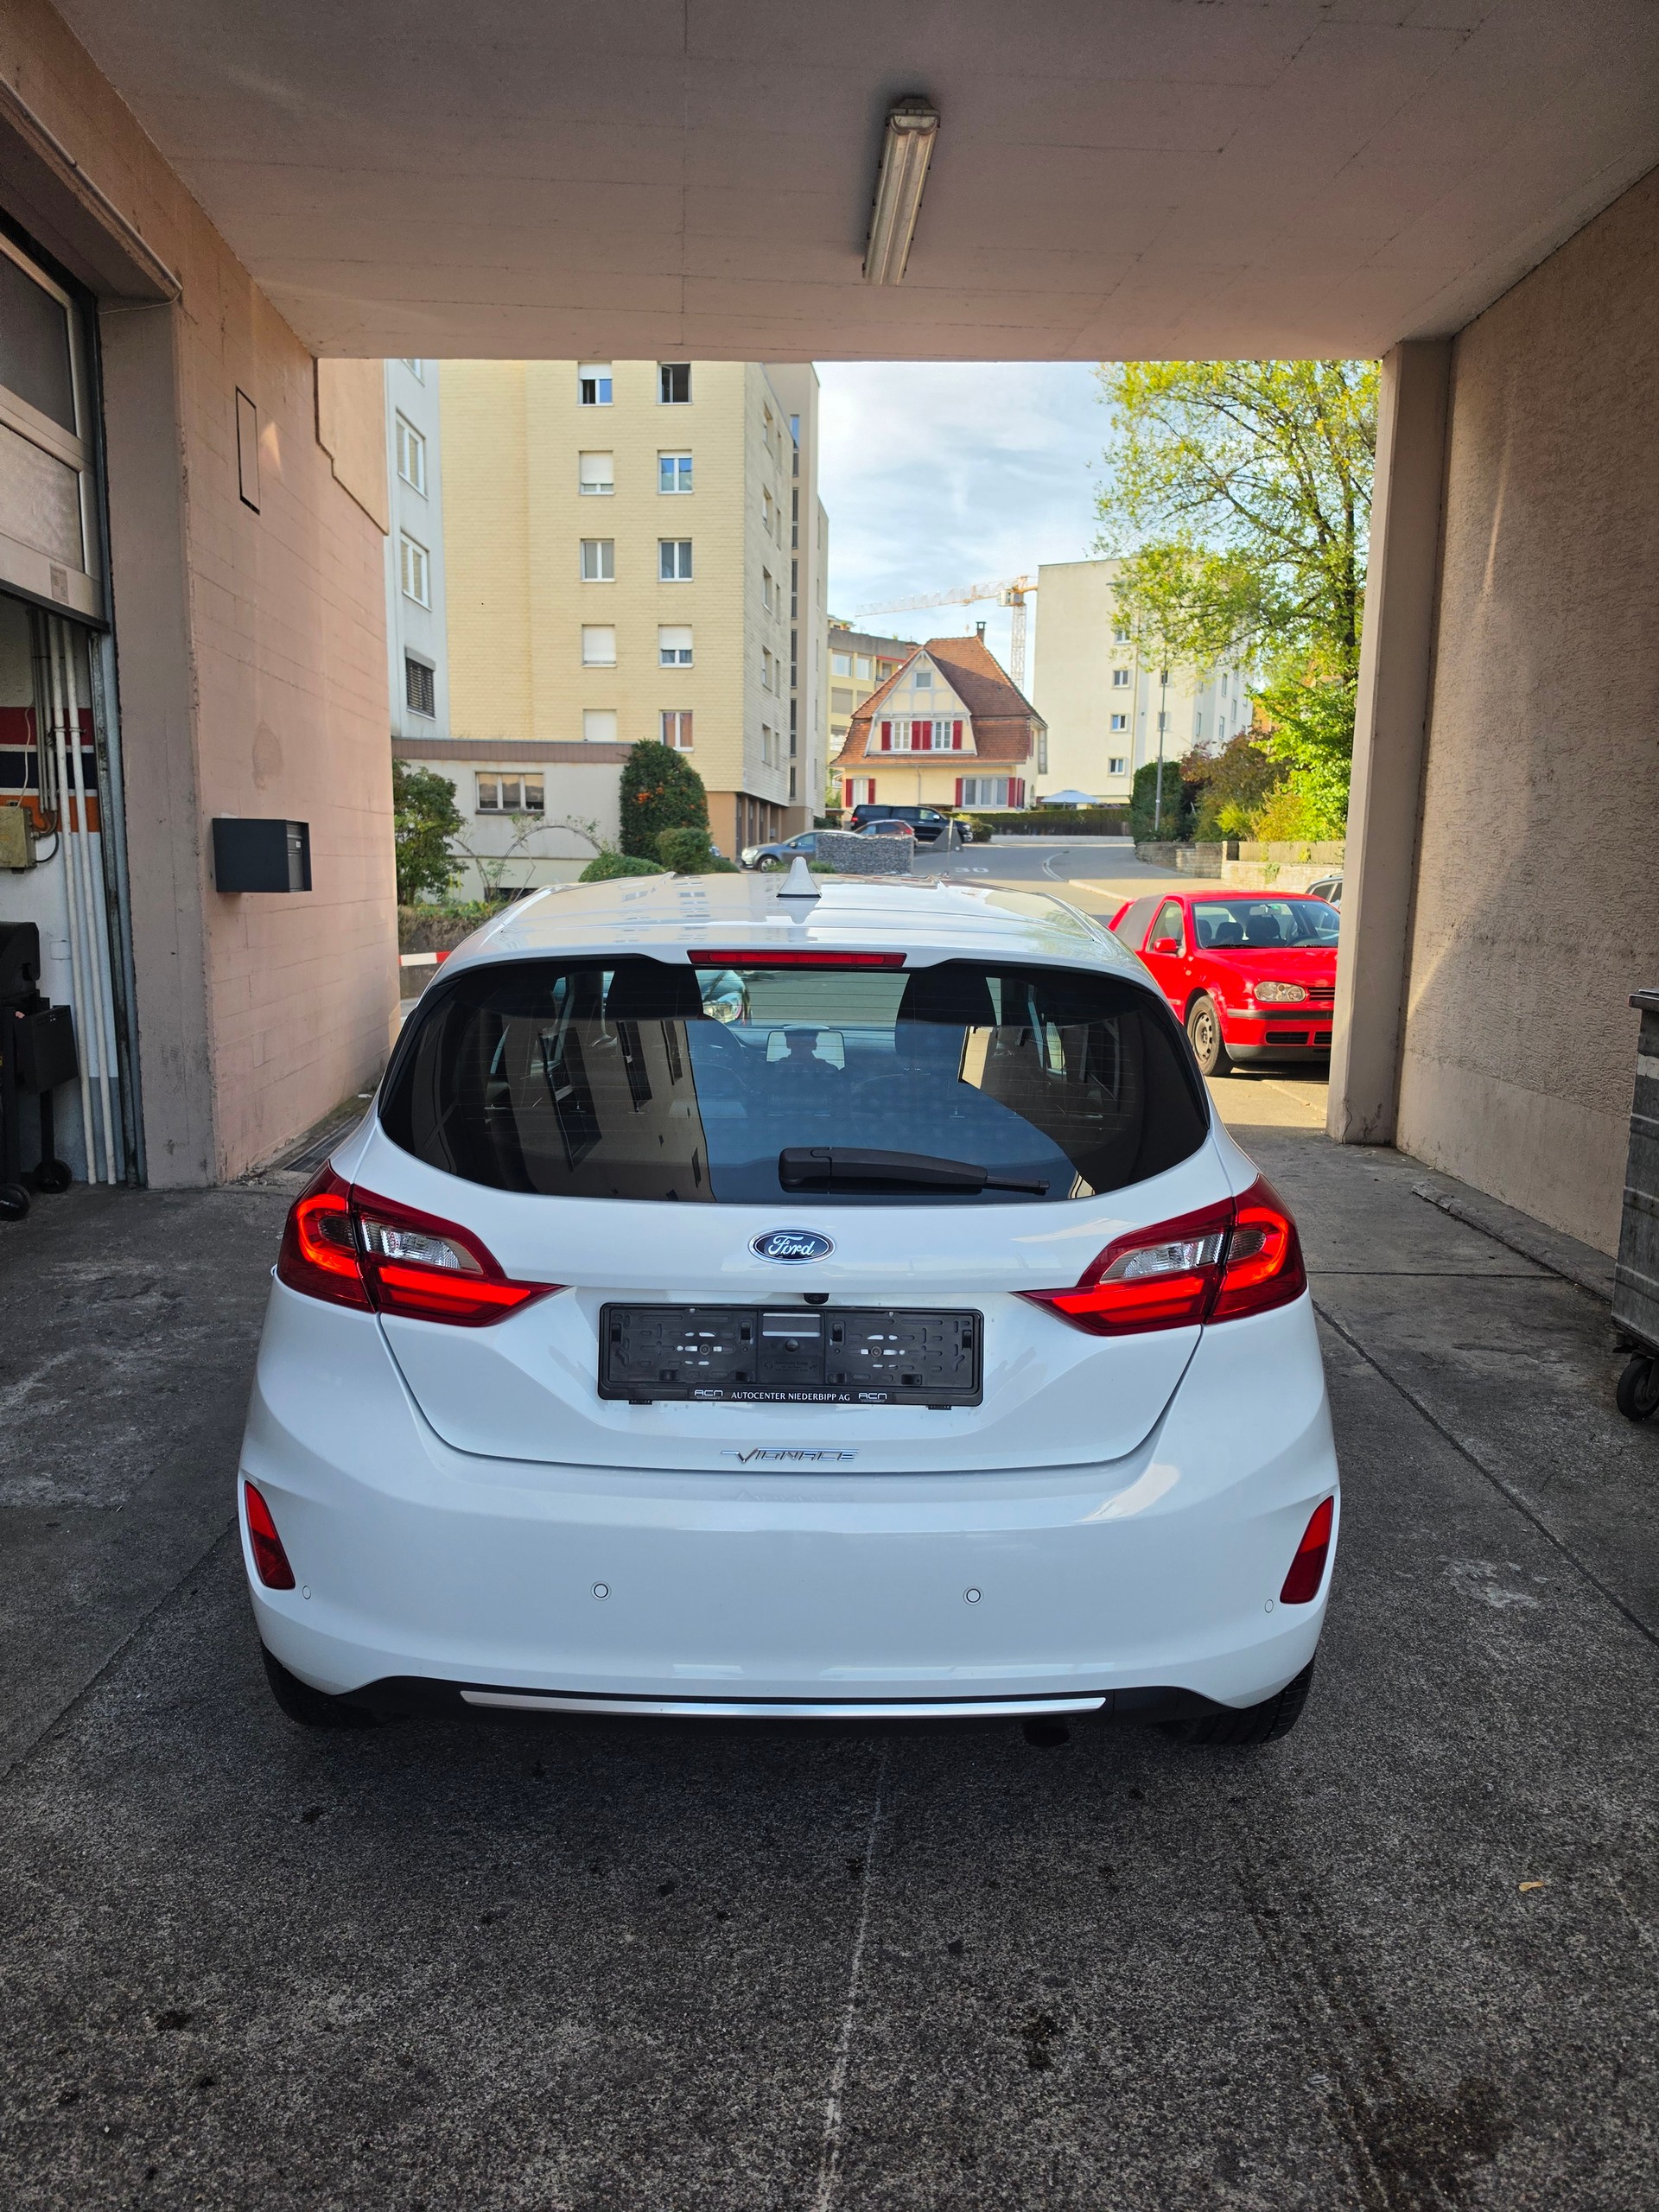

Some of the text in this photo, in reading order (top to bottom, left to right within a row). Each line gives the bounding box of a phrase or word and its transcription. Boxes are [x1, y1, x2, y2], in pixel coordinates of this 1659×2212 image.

[767, 1235, 816, 1255] Ford
[731, 1391, 785, 1400] AUTOCENTER
[788, 1392, 836, 1401] NIEDERBIPP
[838, 1393, 850, 1402] AG
[720, 1447, 860, 1464] VIGNALE
